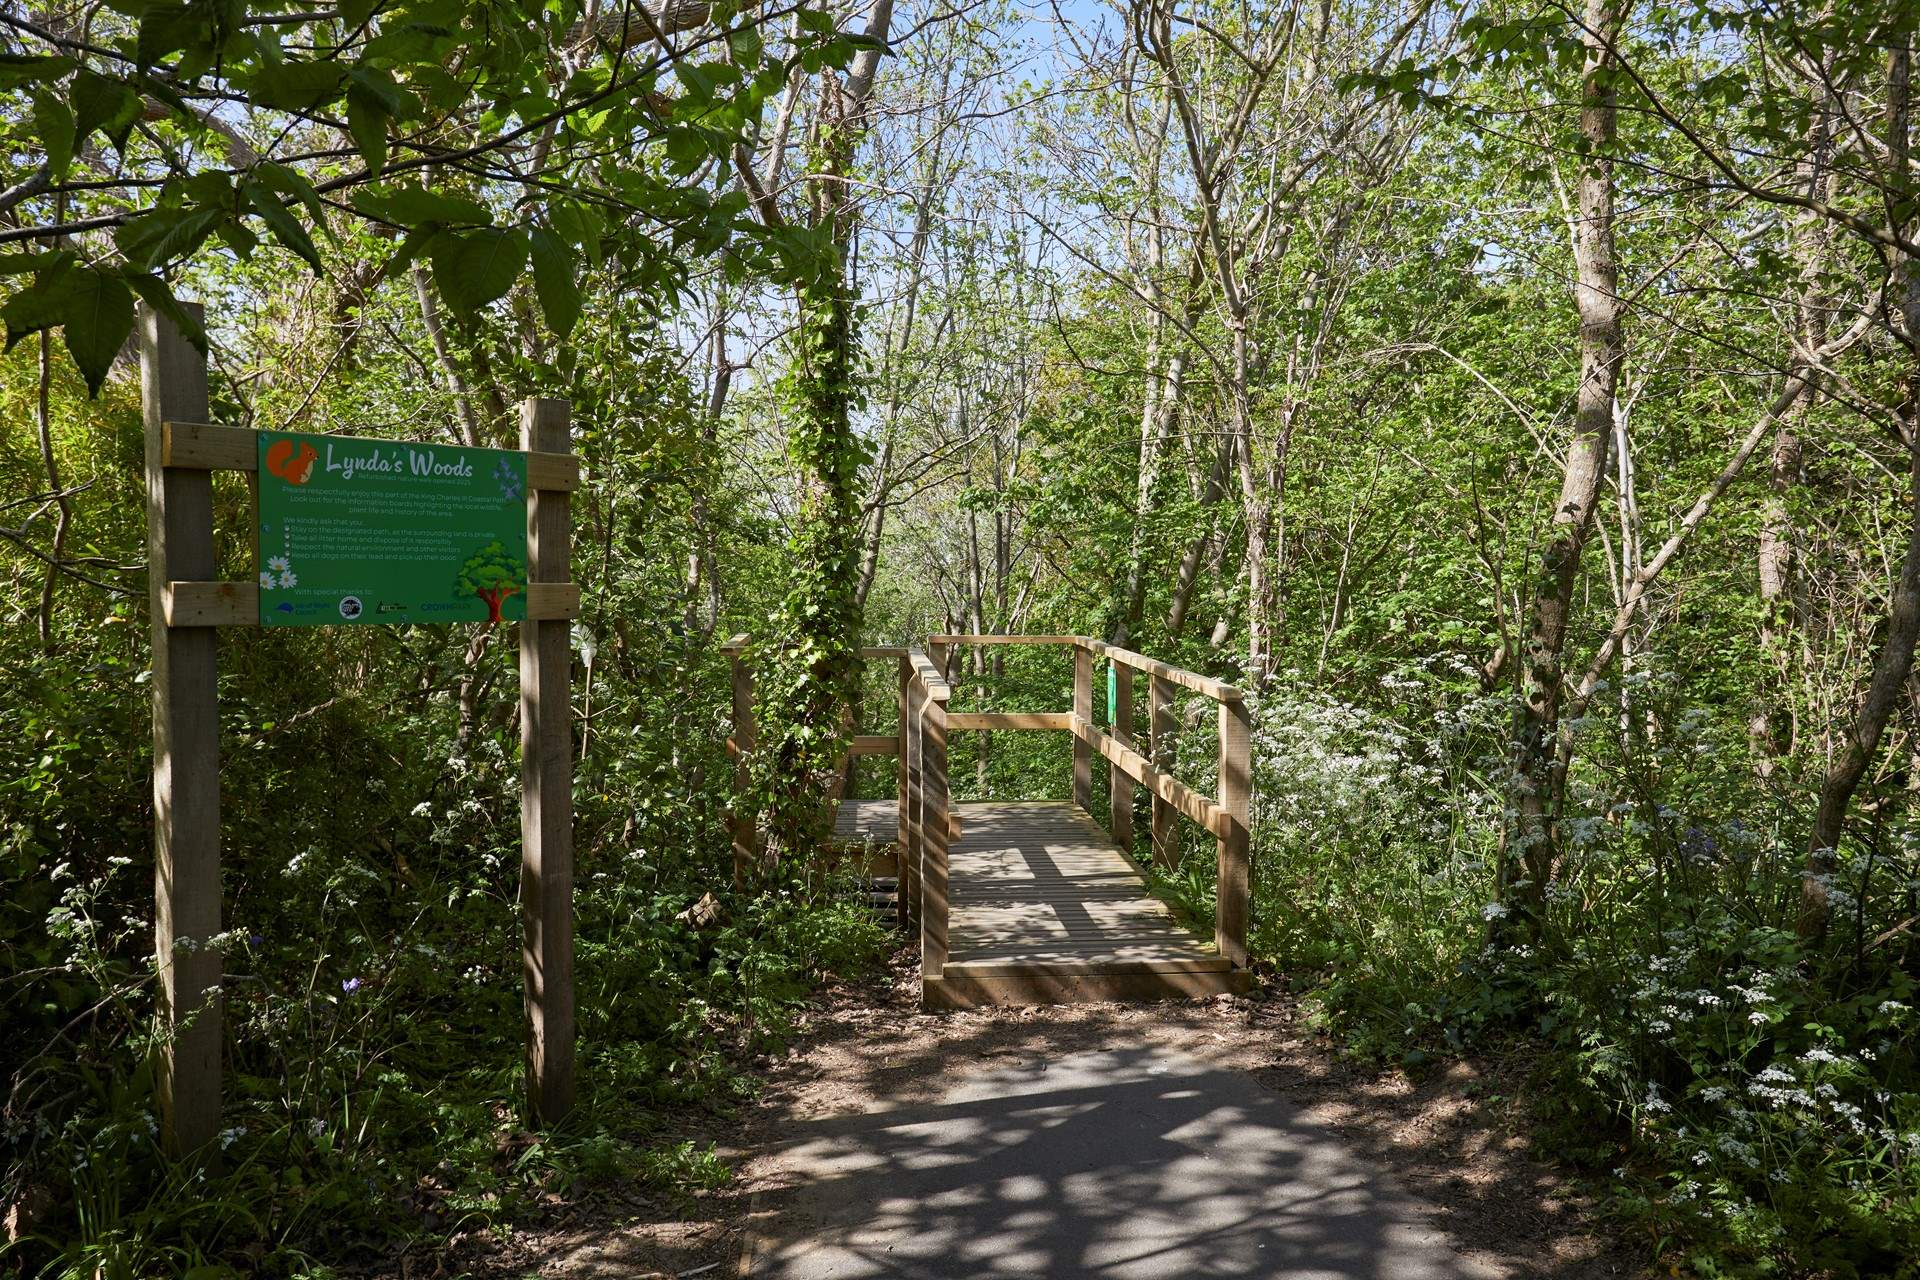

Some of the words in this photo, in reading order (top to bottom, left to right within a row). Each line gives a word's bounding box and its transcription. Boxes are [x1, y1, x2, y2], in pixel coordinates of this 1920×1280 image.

[326, 444, 402, 480] Lynda's
[410, 450, 472, 476] Woods
[308, 488, 350, 498] respectfully
[385, 491, 399, 500] part
[421, 493, 436, 502] King
[348, 498, 388, 506] information
[412, 501, 452, 510] highlighting
[349, 507, 368, 515] plant
[394, 509, 417, 517] history
[297, 517, 318, 525] kindly
[291, 526, 308, 534] Stay
[332, 527, 372, 536] designated
[412, 529, 452, 538] surrounding
[374, 537, 400, 545] dispose
[292, 543, 320, 551] Respect
